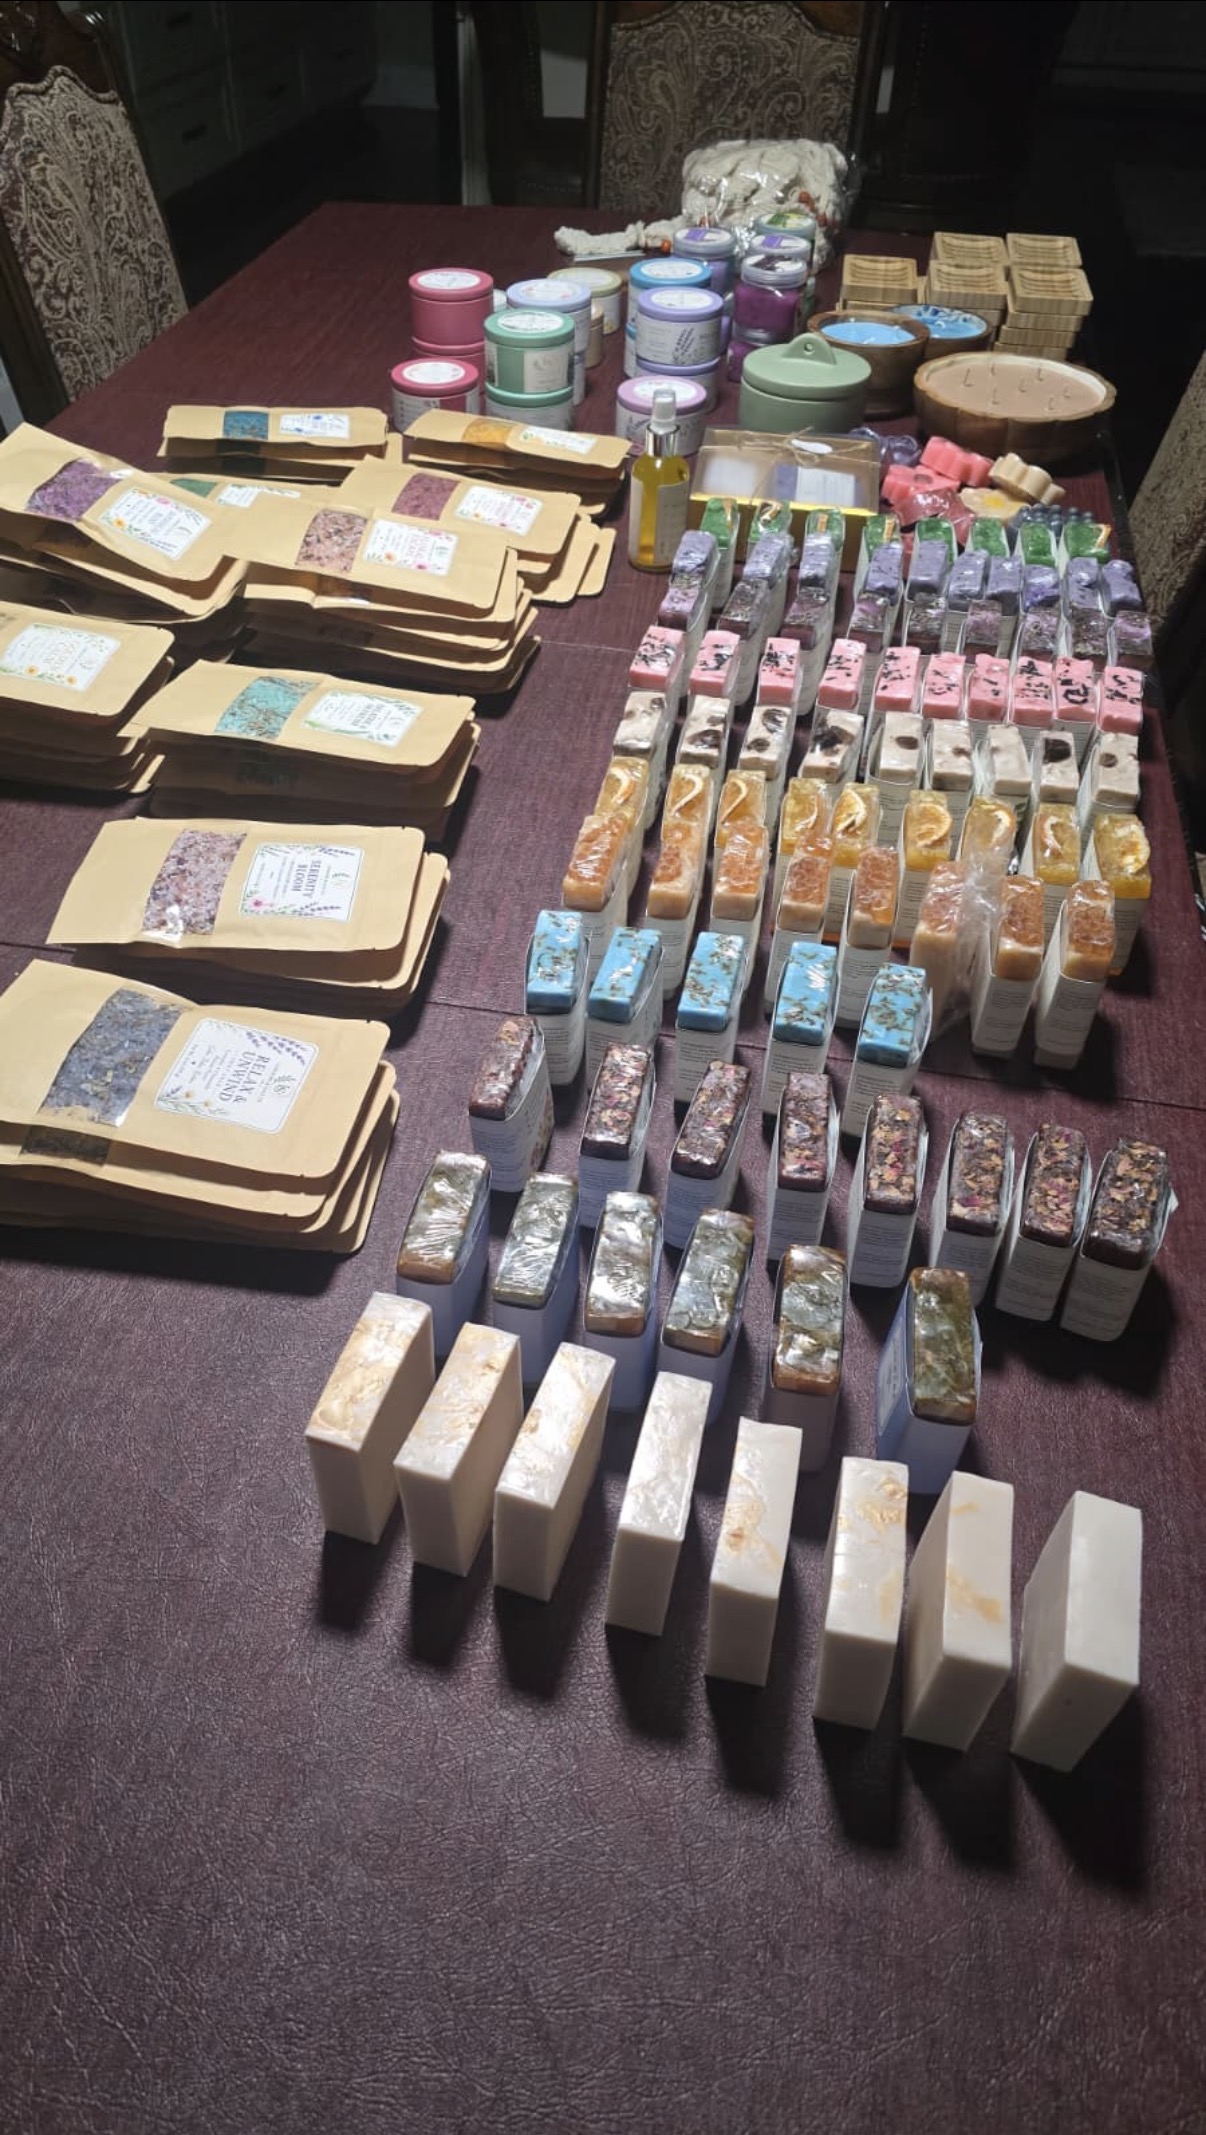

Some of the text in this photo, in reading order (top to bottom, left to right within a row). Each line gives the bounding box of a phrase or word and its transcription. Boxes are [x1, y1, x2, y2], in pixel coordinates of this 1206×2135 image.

[291, 864, 308, 892] BLOOM
[302, 859, 322, 899] SERENITY
[219, 1051, 256, 1102] UNWIND
[239, 1054, 271, 1093] RELAX
[233, 1094, 247, 1103] &
